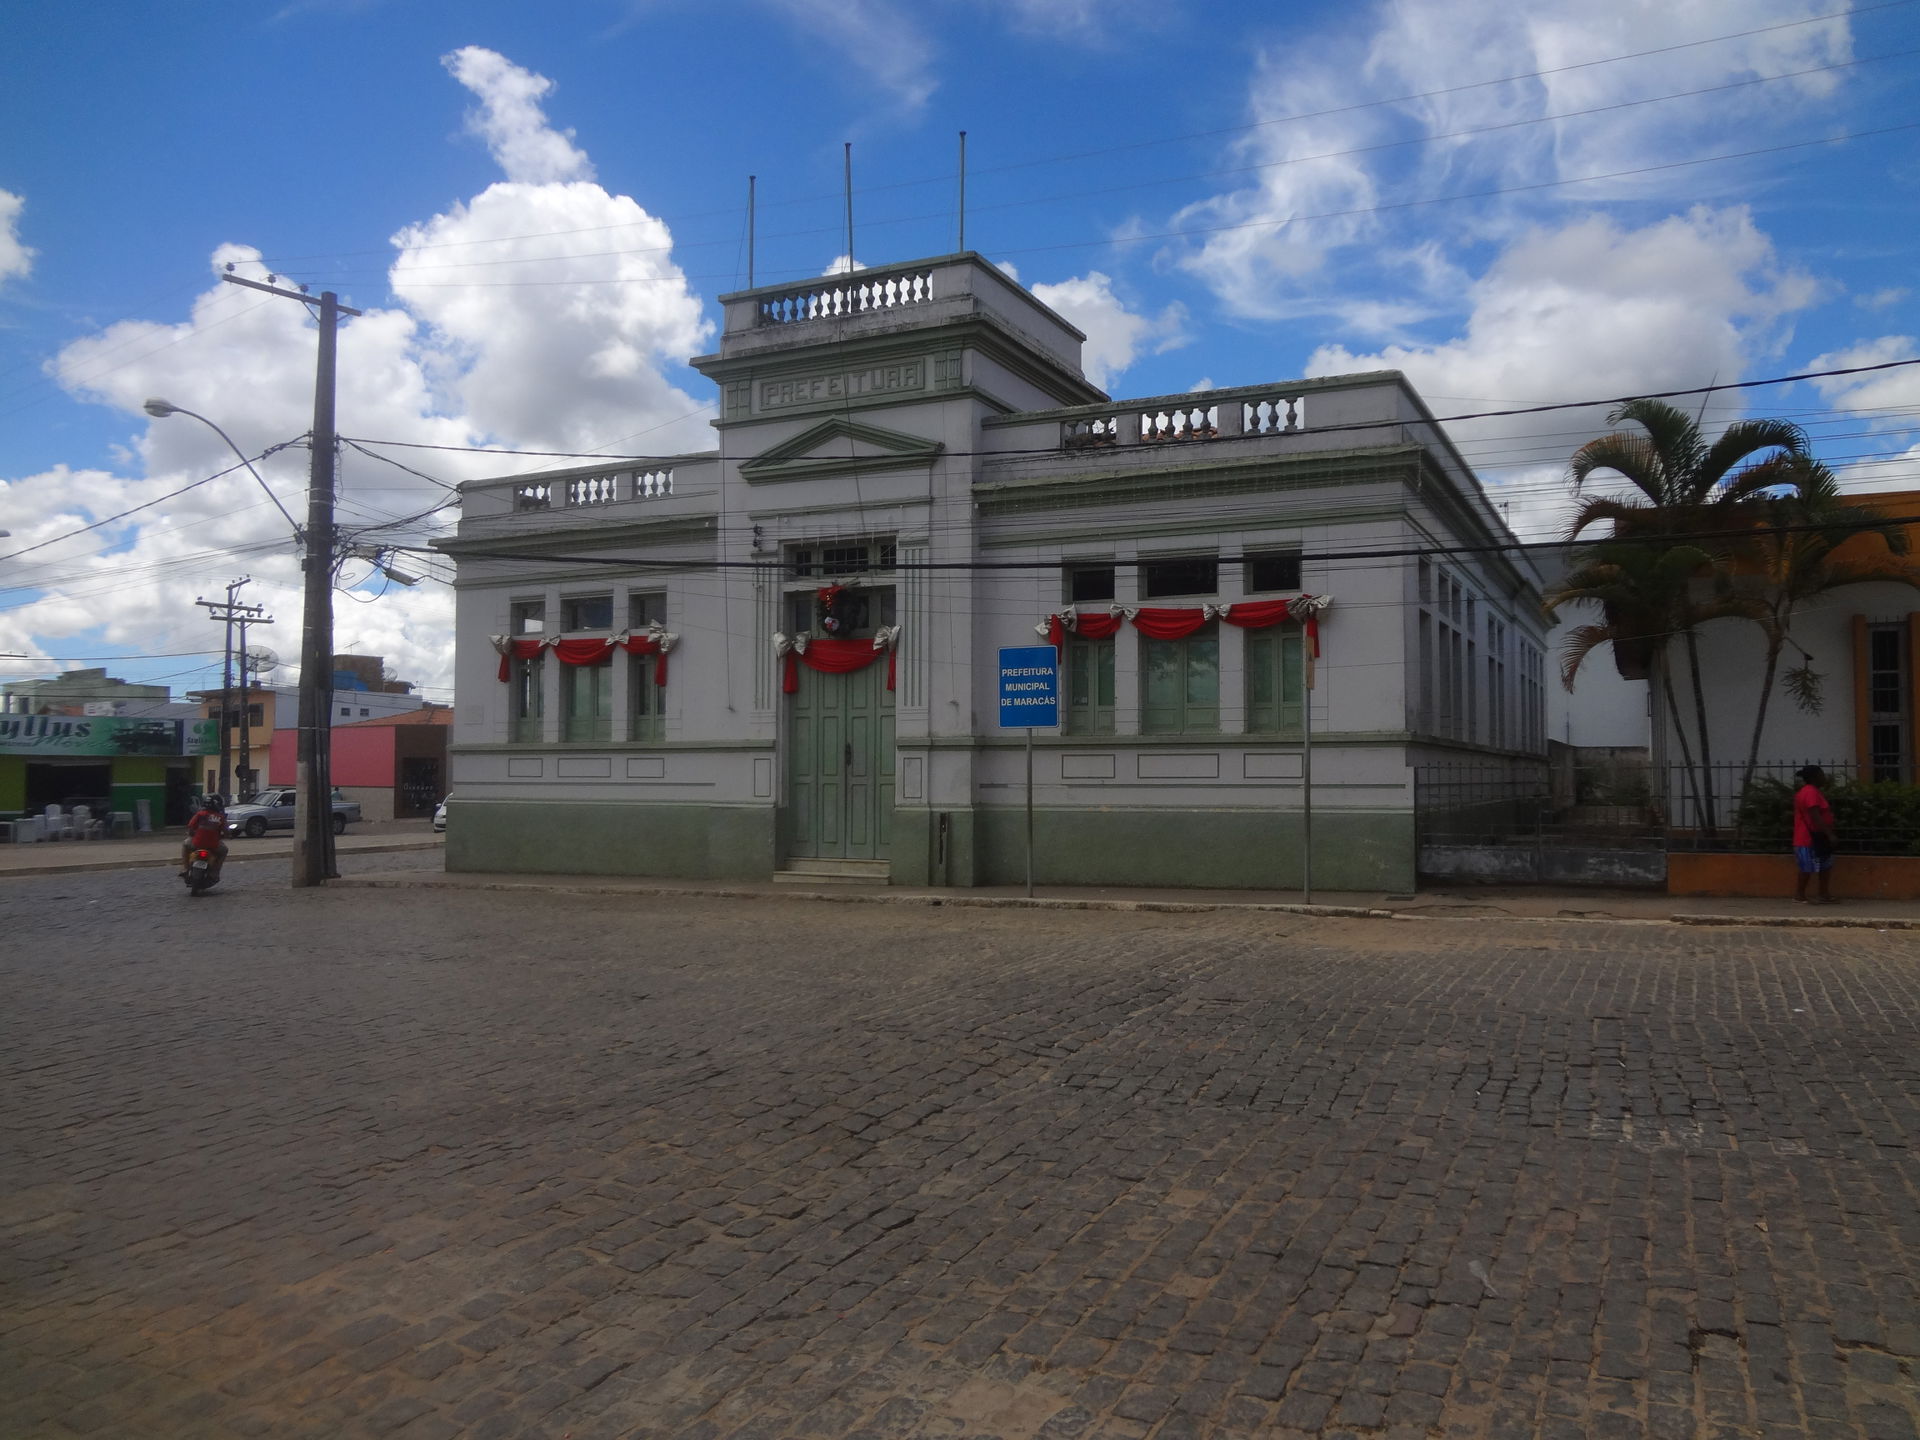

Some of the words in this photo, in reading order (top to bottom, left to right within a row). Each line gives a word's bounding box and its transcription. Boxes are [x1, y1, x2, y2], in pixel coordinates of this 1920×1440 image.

[764, 362, 919, 405] PREFEITURA
[1001, 667, 1054, 677] PREFEITURA
[1005, 682, 1050, 691] MUNICIPAL
[1001, 698, 1012, 706] DE
[1013, 696, 1056, 706] MARACÁS
